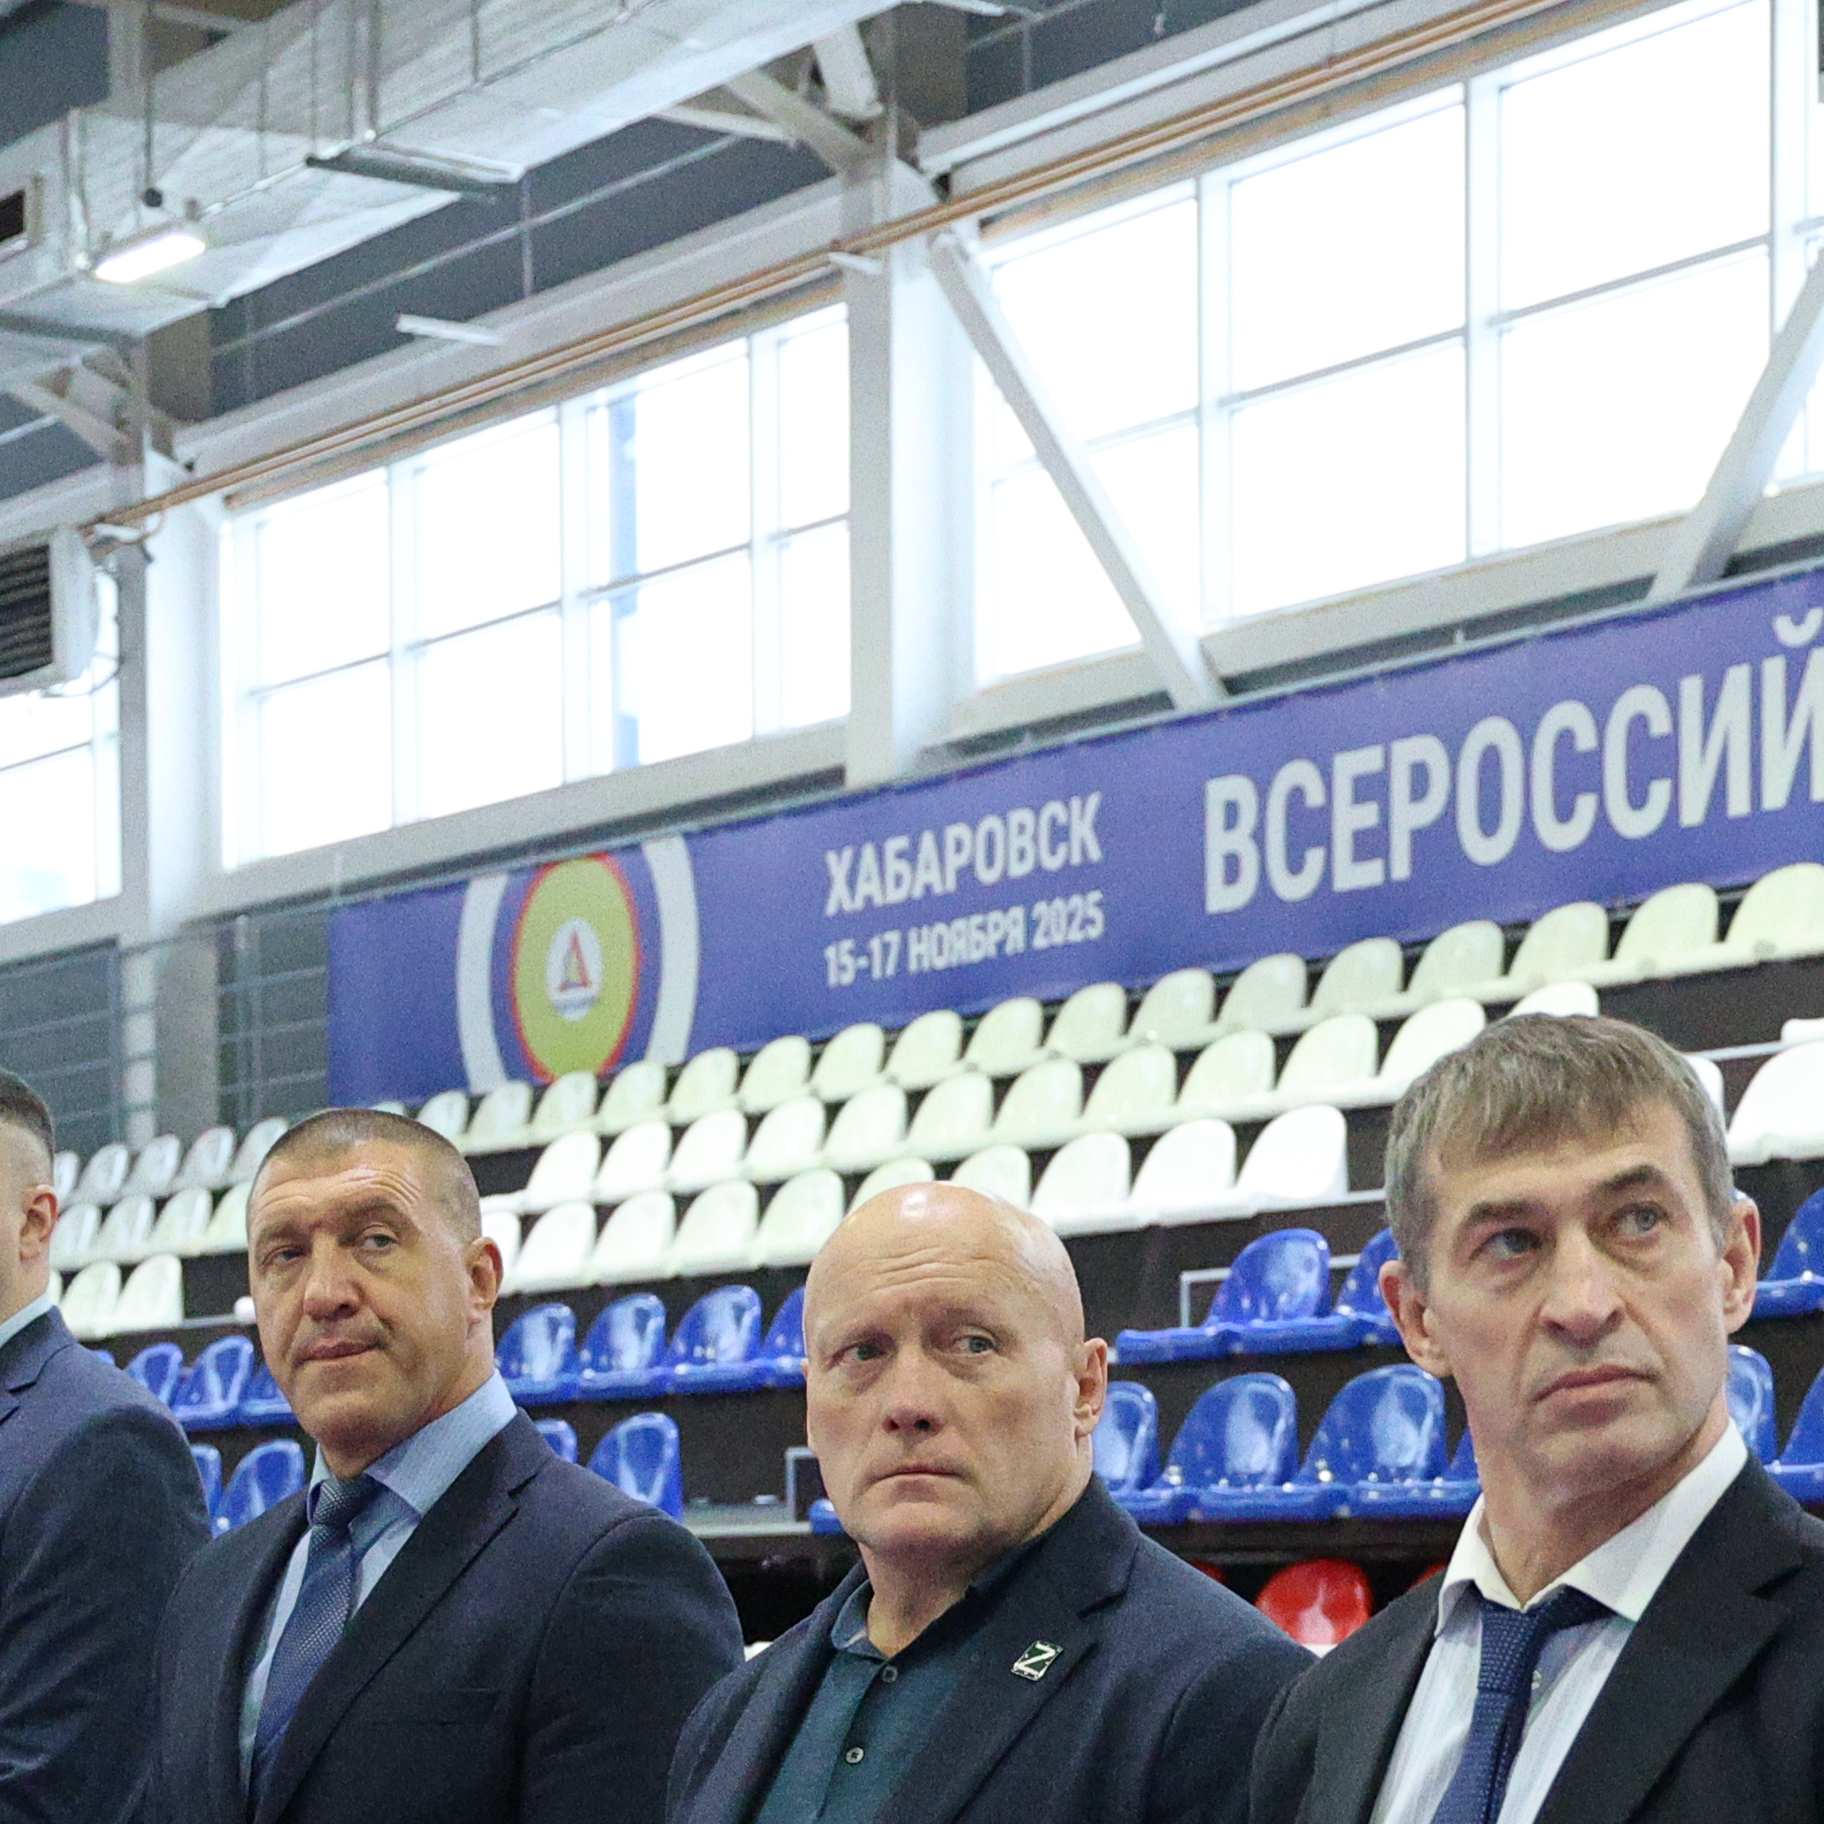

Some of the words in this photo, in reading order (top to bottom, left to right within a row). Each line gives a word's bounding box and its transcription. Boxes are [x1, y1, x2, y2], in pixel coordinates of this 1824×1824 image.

[823, 790, 1103, 917] ХАБАРОВСК
[823, 930, 902, 987] 15-17
[907, 905, 1026, 974] НОЯБРЯ
[1031, 889, 1106, 951] 2025
